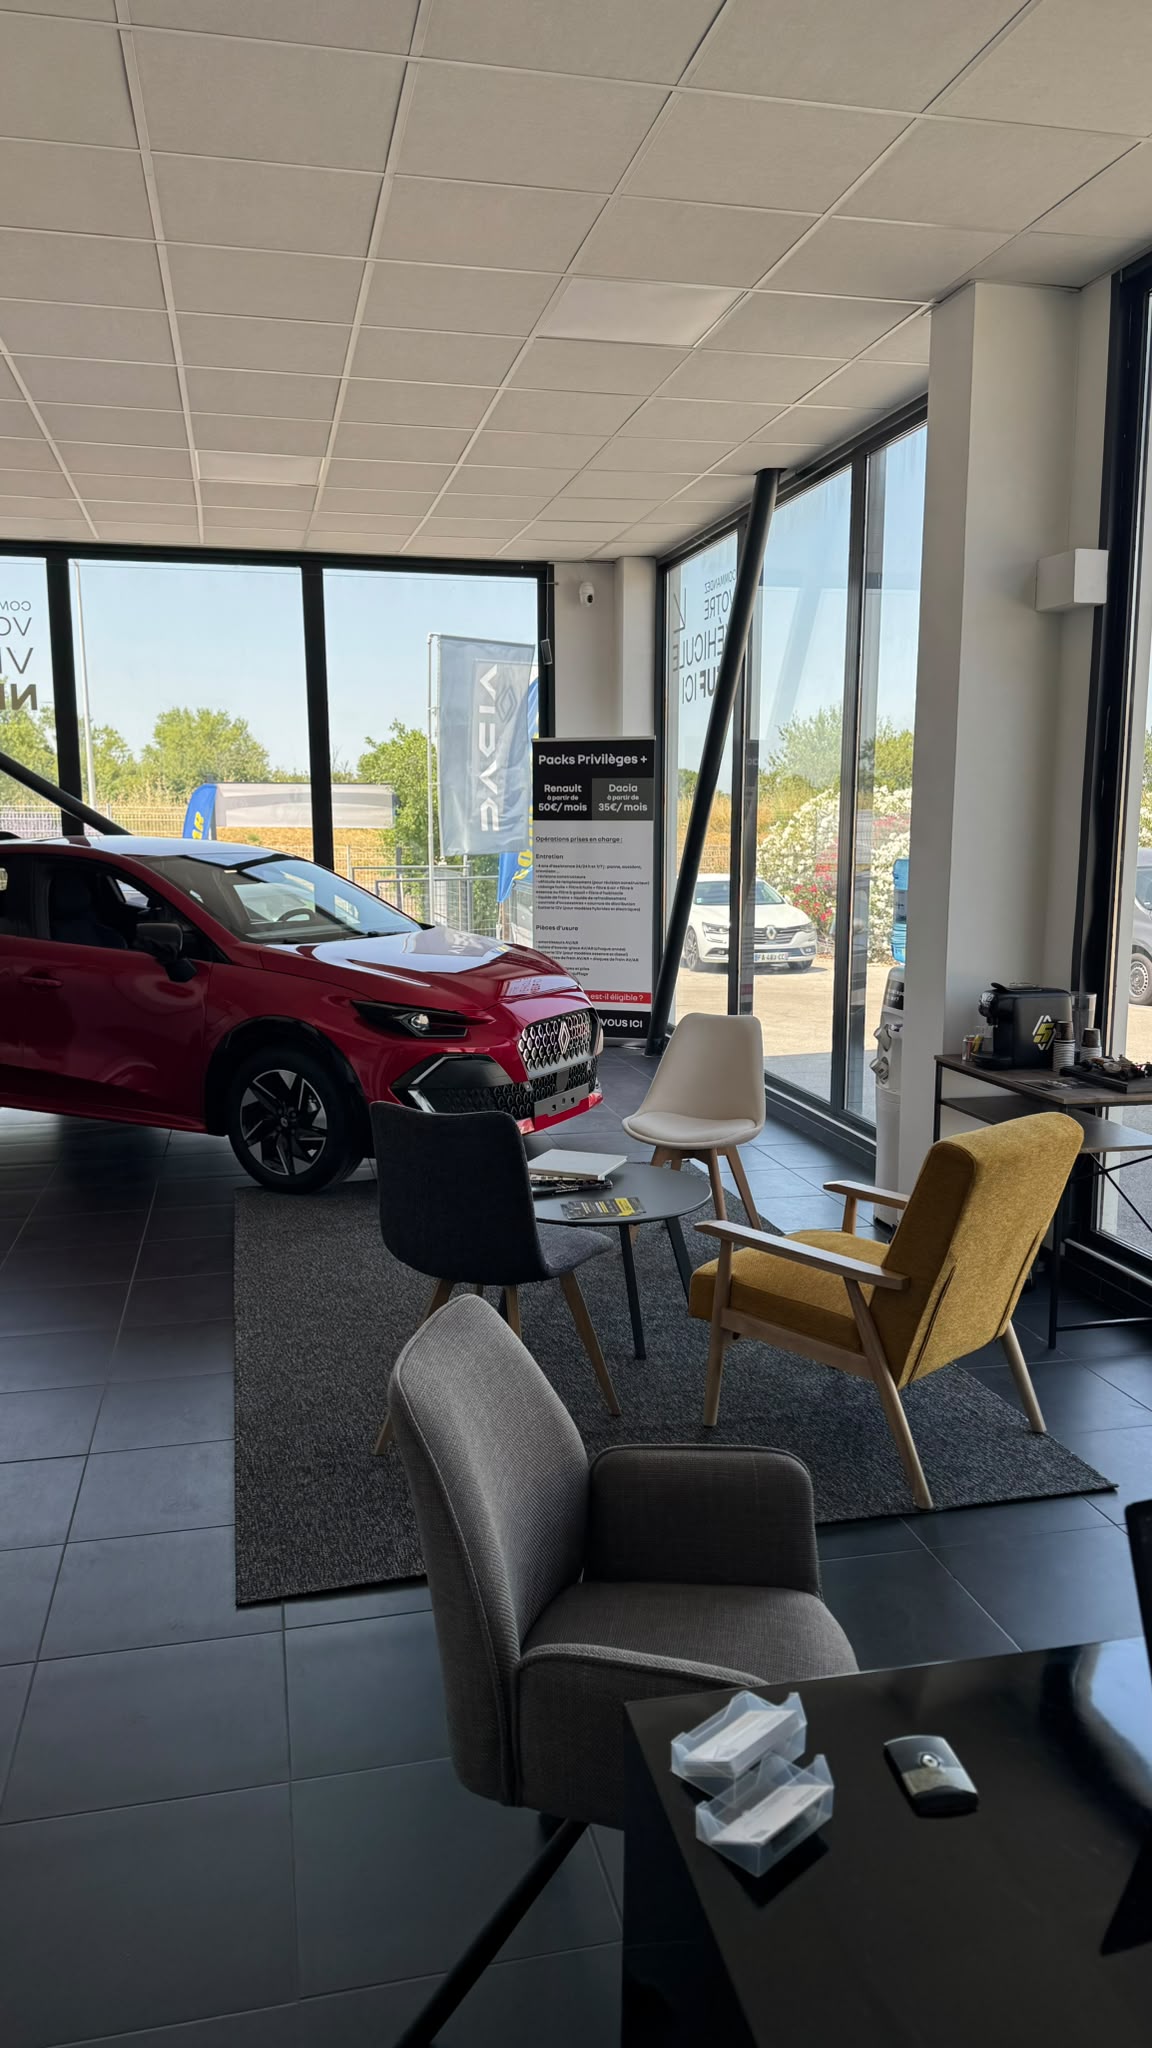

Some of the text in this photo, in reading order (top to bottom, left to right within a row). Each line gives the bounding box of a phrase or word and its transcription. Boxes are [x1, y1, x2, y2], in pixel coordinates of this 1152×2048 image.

[538, 754, 575, 765] Packs
[578, 754, 638, 767] Privilèges
[544, 784, 582, 793] Renault
[609, 784, 638, 792] Dacia
[564, 803, 587, 811] mois
[624, 803, 647, 811] mois
[610, 994, 638, 1002] éligible
[601, 1019, 642, 1028] VOUS ICI
